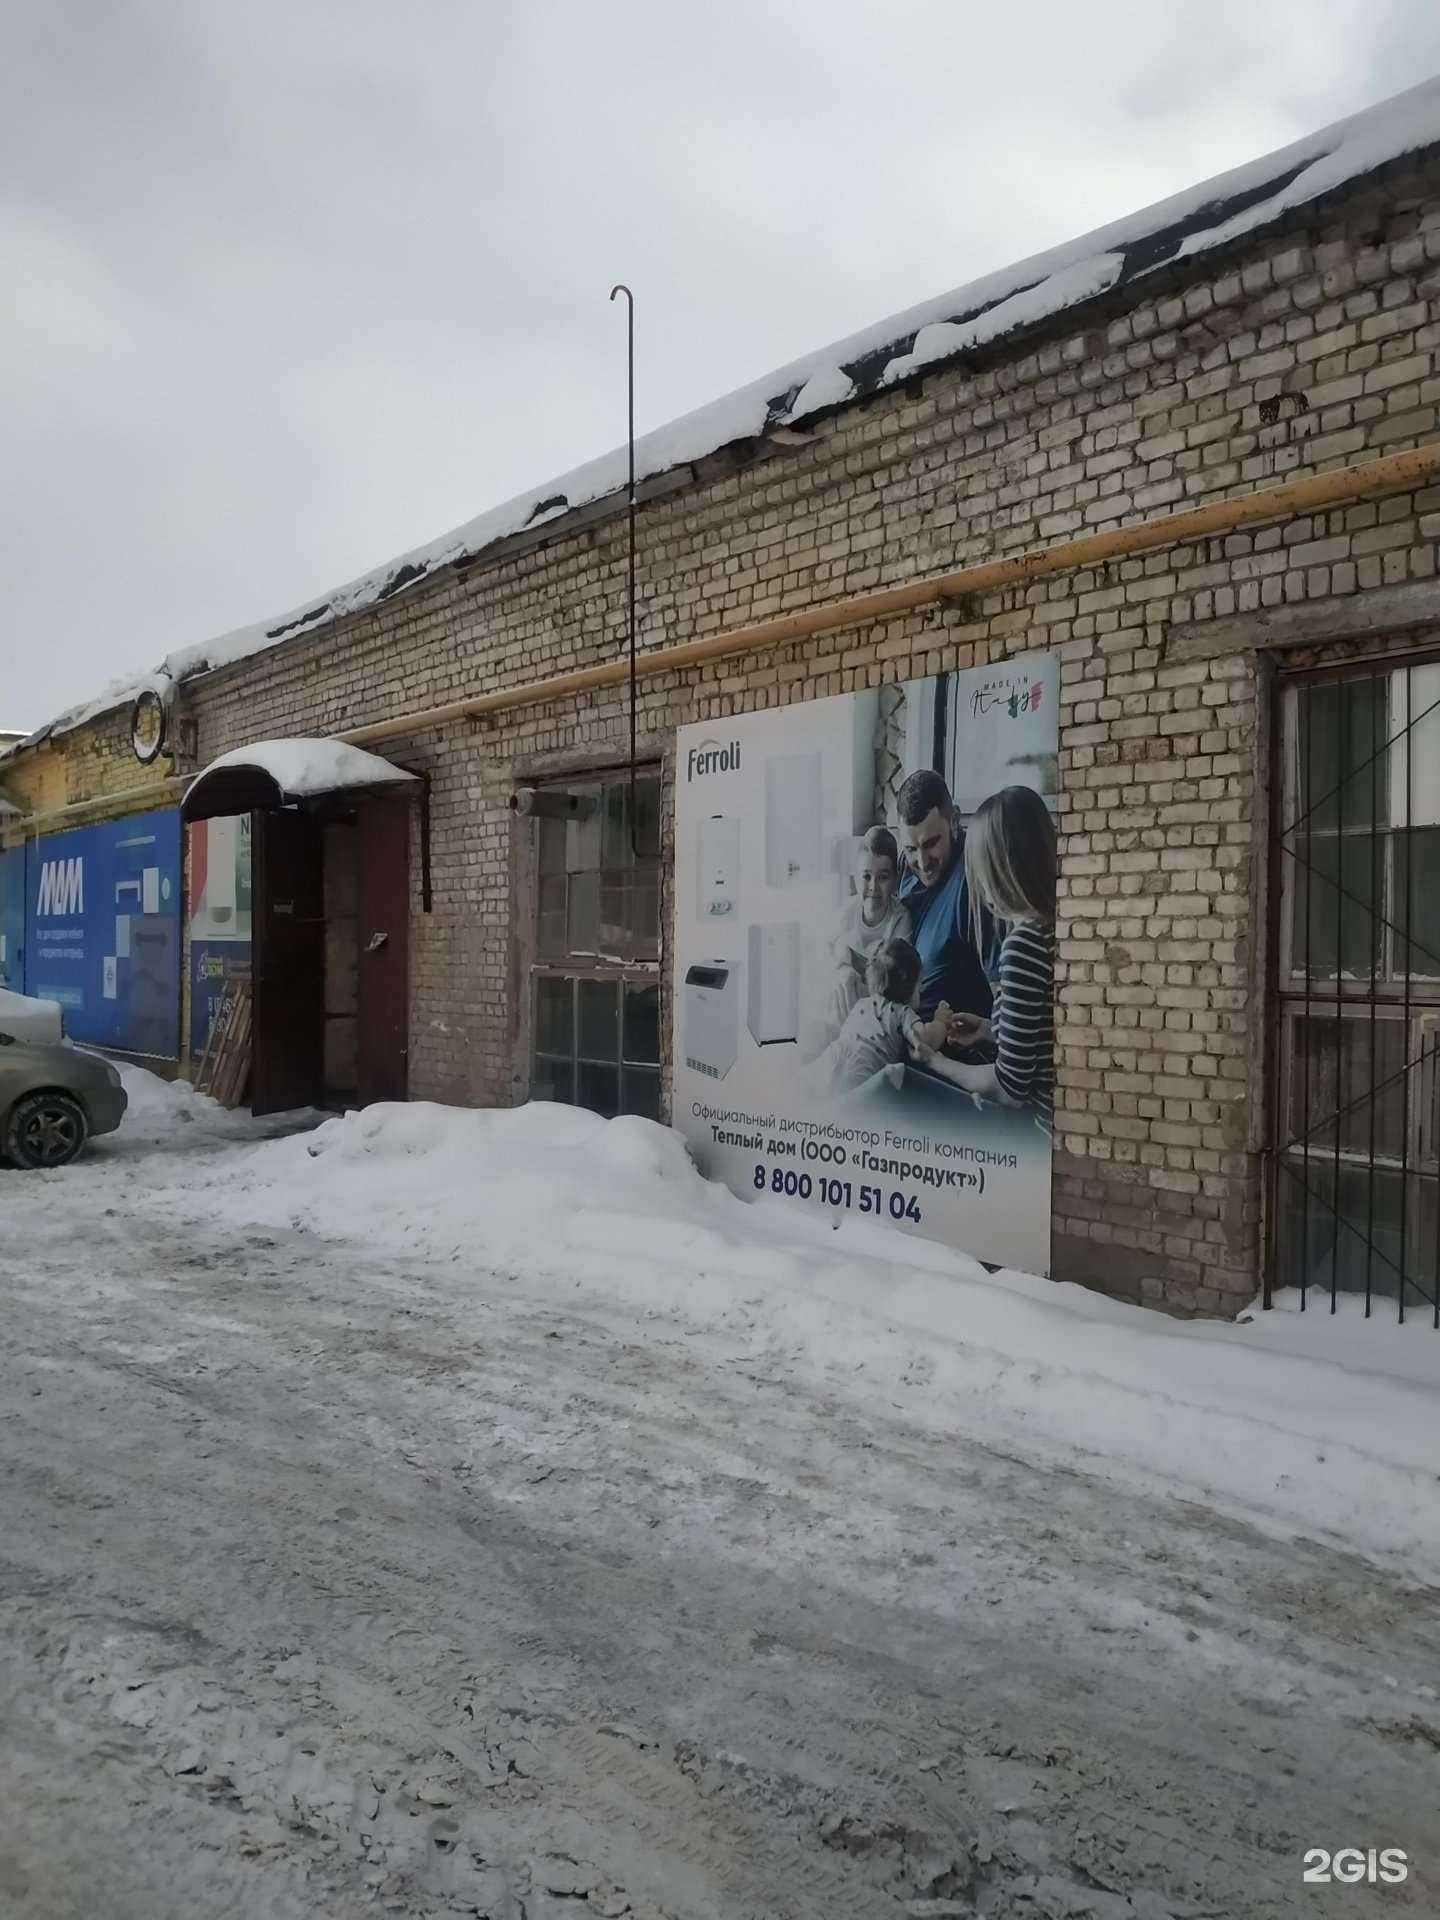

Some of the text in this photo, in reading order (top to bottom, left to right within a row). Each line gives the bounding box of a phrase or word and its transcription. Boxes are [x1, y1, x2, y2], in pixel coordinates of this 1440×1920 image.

[984, 676, 1029, 691] MADE IN
[687, 740, 741, 782] Ferroli
[691, 1101, 1017, 1168] Официальный дистрибьютор Ferroli компания
[711, 1125, 985, 1194] Теплый дом (ООО «Газпродукт»)
[753, 1164, 922, 1223] 8 800 101 51 04
